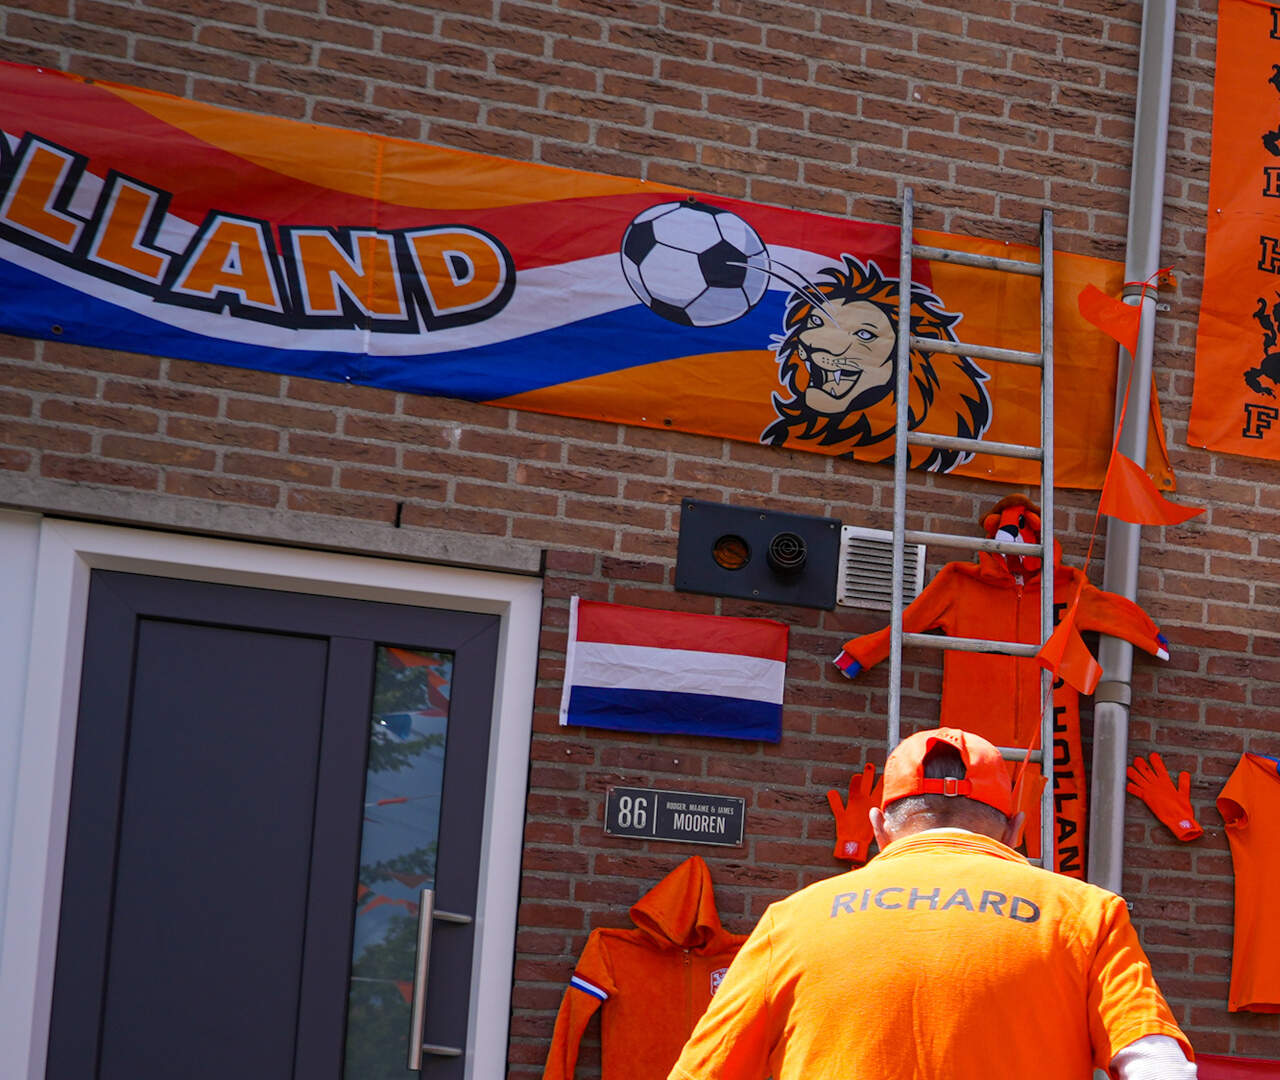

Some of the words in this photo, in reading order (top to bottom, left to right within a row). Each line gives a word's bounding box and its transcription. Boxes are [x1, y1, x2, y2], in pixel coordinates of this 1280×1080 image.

[0, 131, 516, 334] LLAND
[618, 796, 648, 829] 86
[673, 813, 726, 834] MOOREN
[830, 887, 1041, 924] RICHARD
